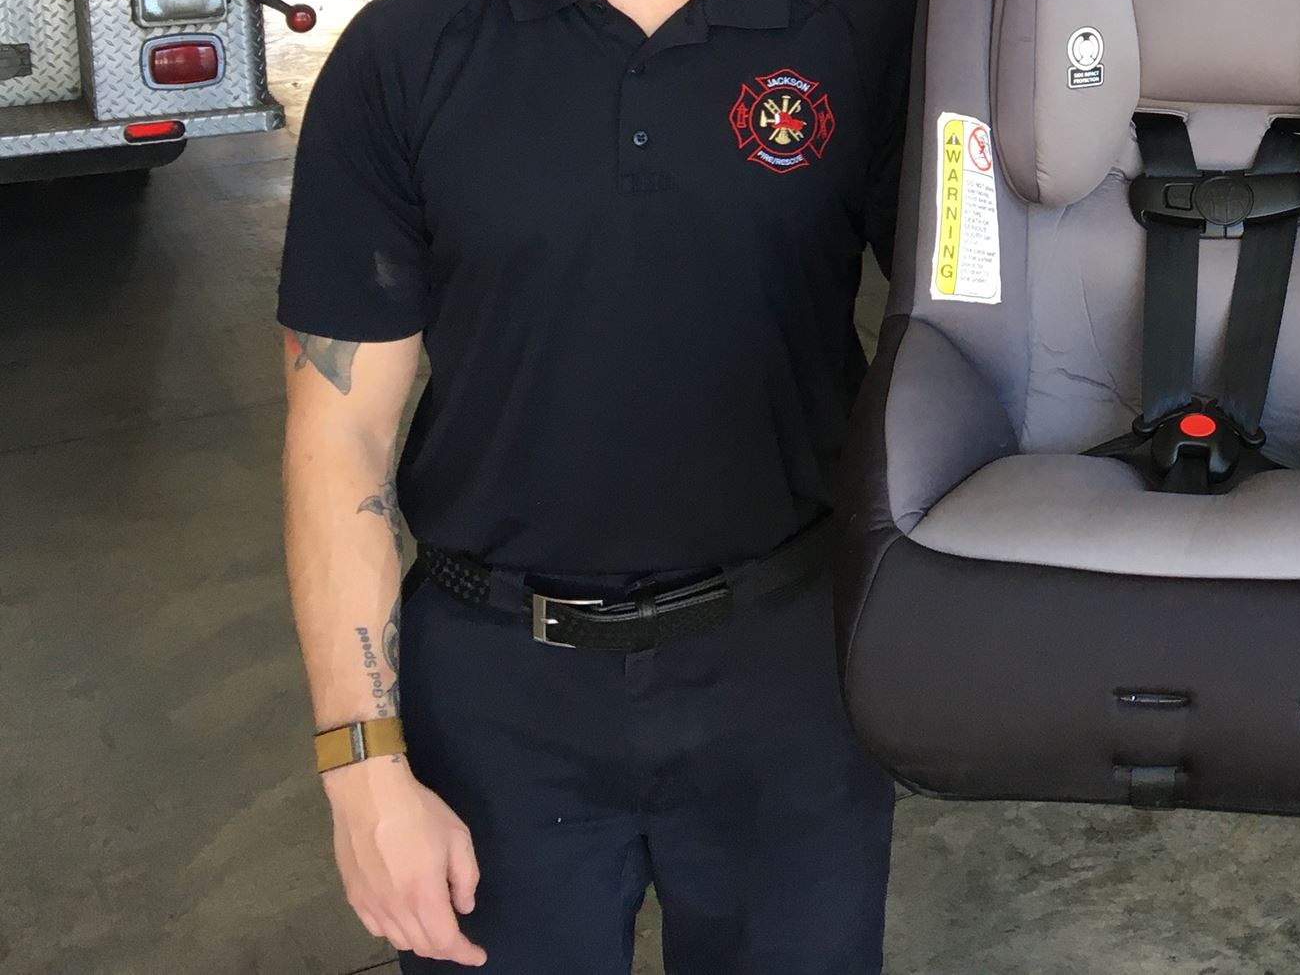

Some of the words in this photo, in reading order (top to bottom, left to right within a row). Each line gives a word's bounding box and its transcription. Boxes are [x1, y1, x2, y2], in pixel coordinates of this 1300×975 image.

[766, 76, 811, 92] JACKSON
[940, 149, 962, 279] WARNING
[355, 627, 377, 668] Speed
[367, 672, 384, 699] God
